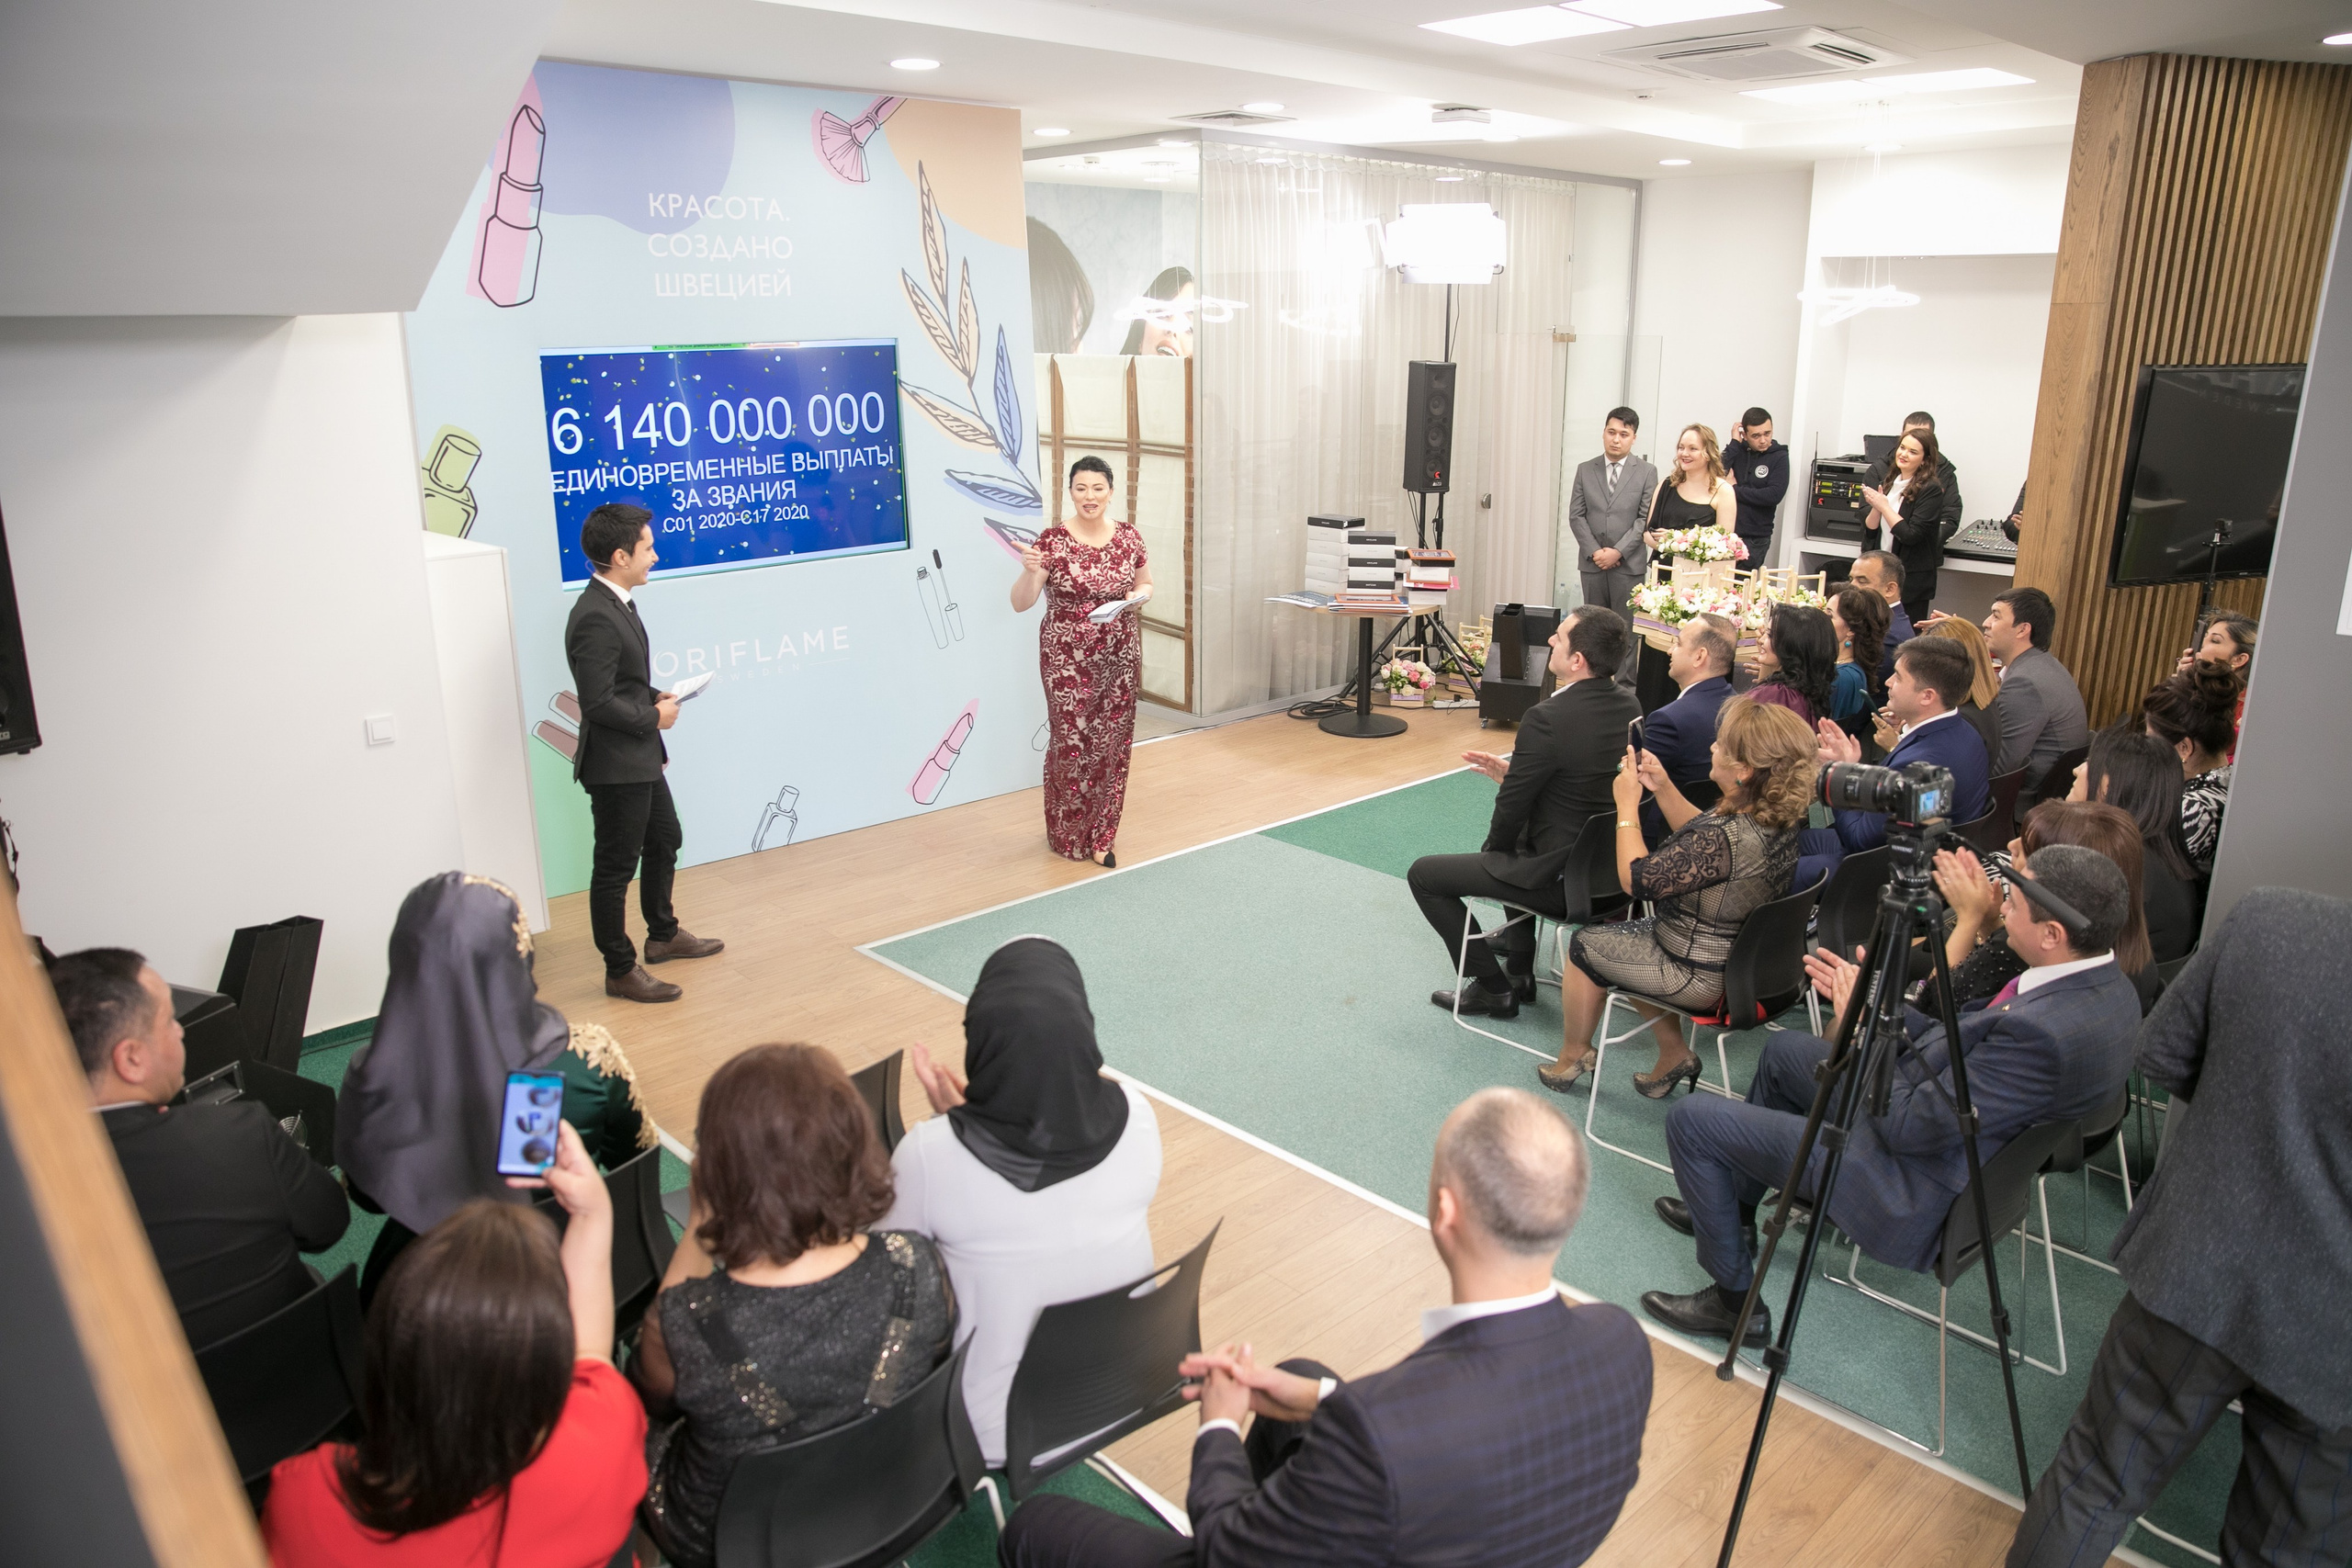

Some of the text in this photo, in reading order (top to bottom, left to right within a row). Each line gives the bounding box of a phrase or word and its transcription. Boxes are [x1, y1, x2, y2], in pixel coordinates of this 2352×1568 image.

[648, 192, 791, 221] КРАСОТА.
[648, 232, 794, 262] СОЗДАНО
[654, 268, 792, 300] ШВЕЦИЕЙ
[551, 390, 886, 455] 6 140 000 000
[551, 445, 894, 496] ЕДИНОВРЕМЕННЫЕ ВЫПЛАТЫ
[672, 479, 797, 511] ЗА ЗВАНИЯ
[774, 503, 809, 521] 2020
[652, 626, 850, 678] ORIFLAME
[717, 661, 801, 684] SWEDEN
